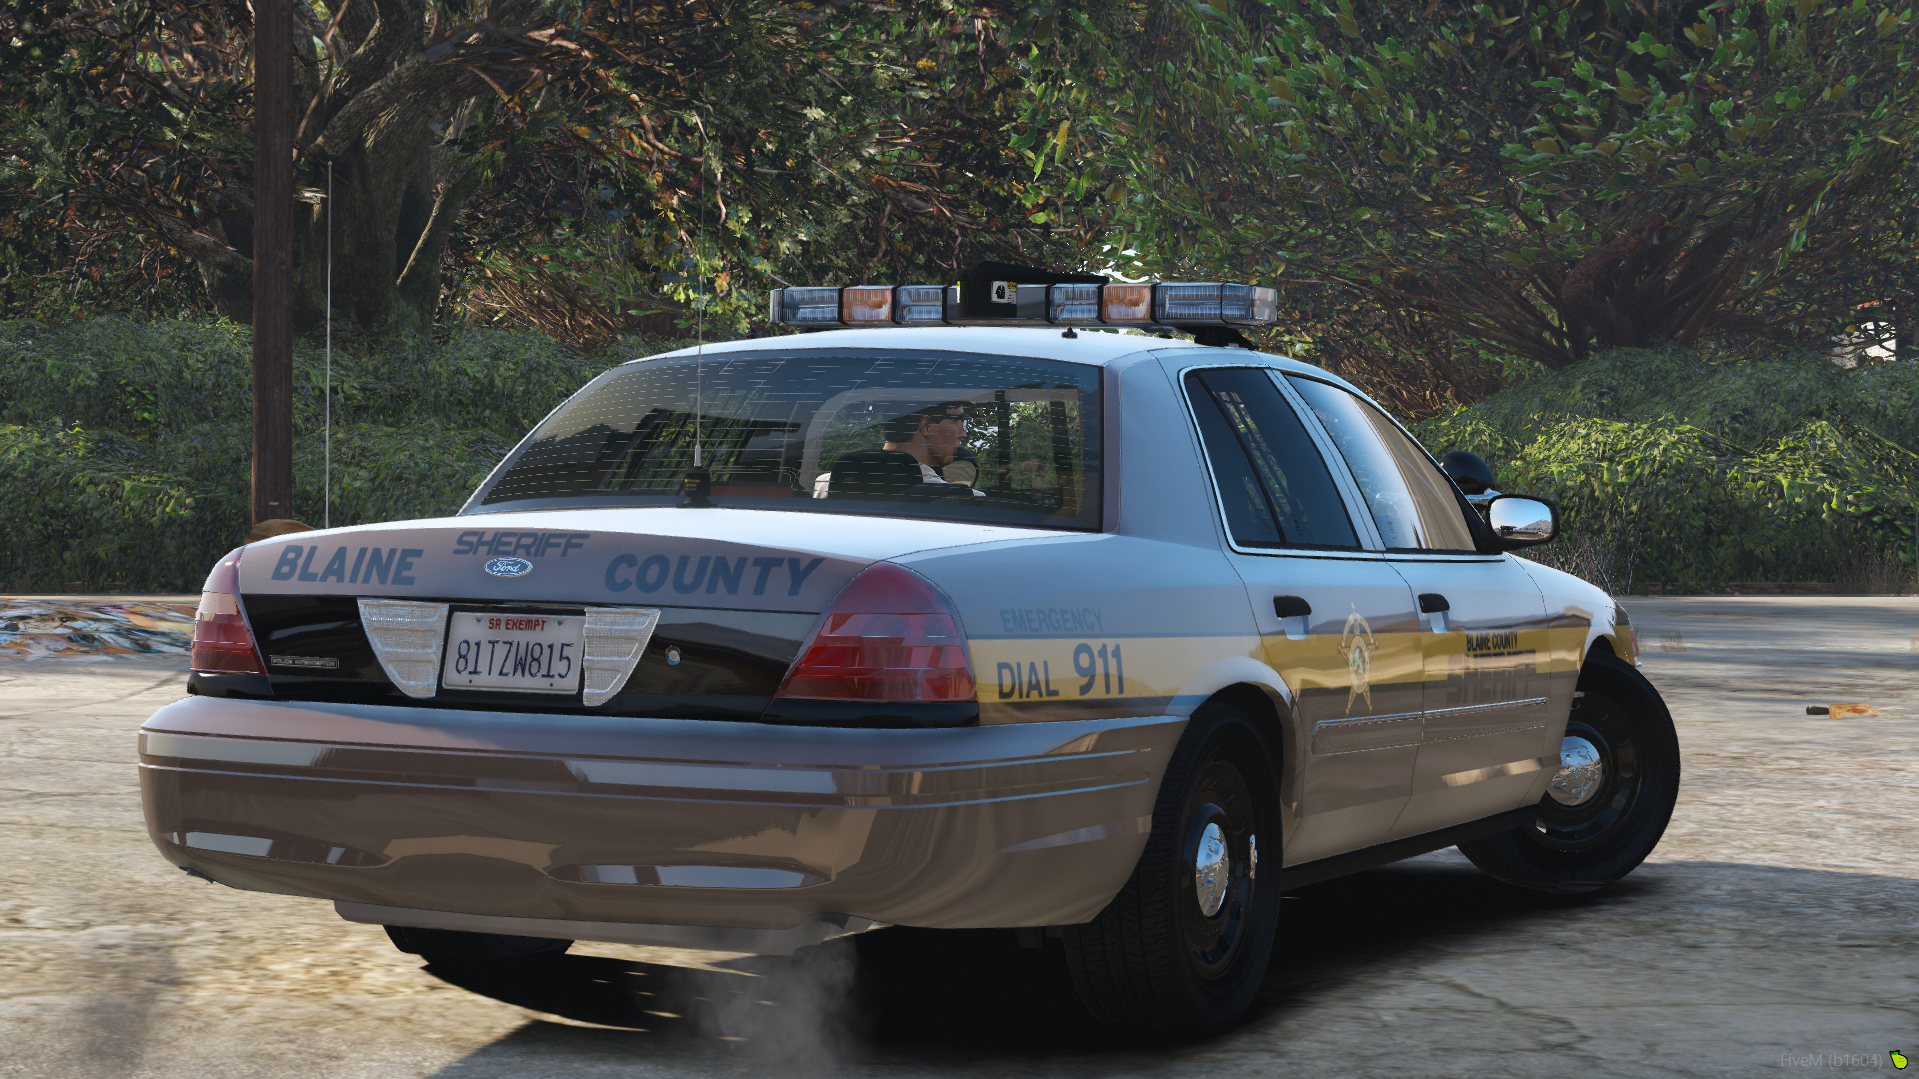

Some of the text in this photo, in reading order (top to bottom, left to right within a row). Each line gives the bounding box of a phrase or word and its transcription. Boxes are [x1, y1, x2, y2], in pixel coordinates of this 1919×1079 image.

[452, 531, 591, 557] SHERIFF
[271, 545, 424, 586] BLAINE
[493, 560, 521, 572] Ford
[604, 553, 827, 596] COUNTY
[488, 617, 548, 631] SA EXEMPT
[1000, 607, 1104, 632] EMERGENCY
[1466, 629, 1518, 652] BLAINE COUNTY
[455, 638, 574, 679] 81TZW815
[997, 643, 1124, 699] DIAL 911
